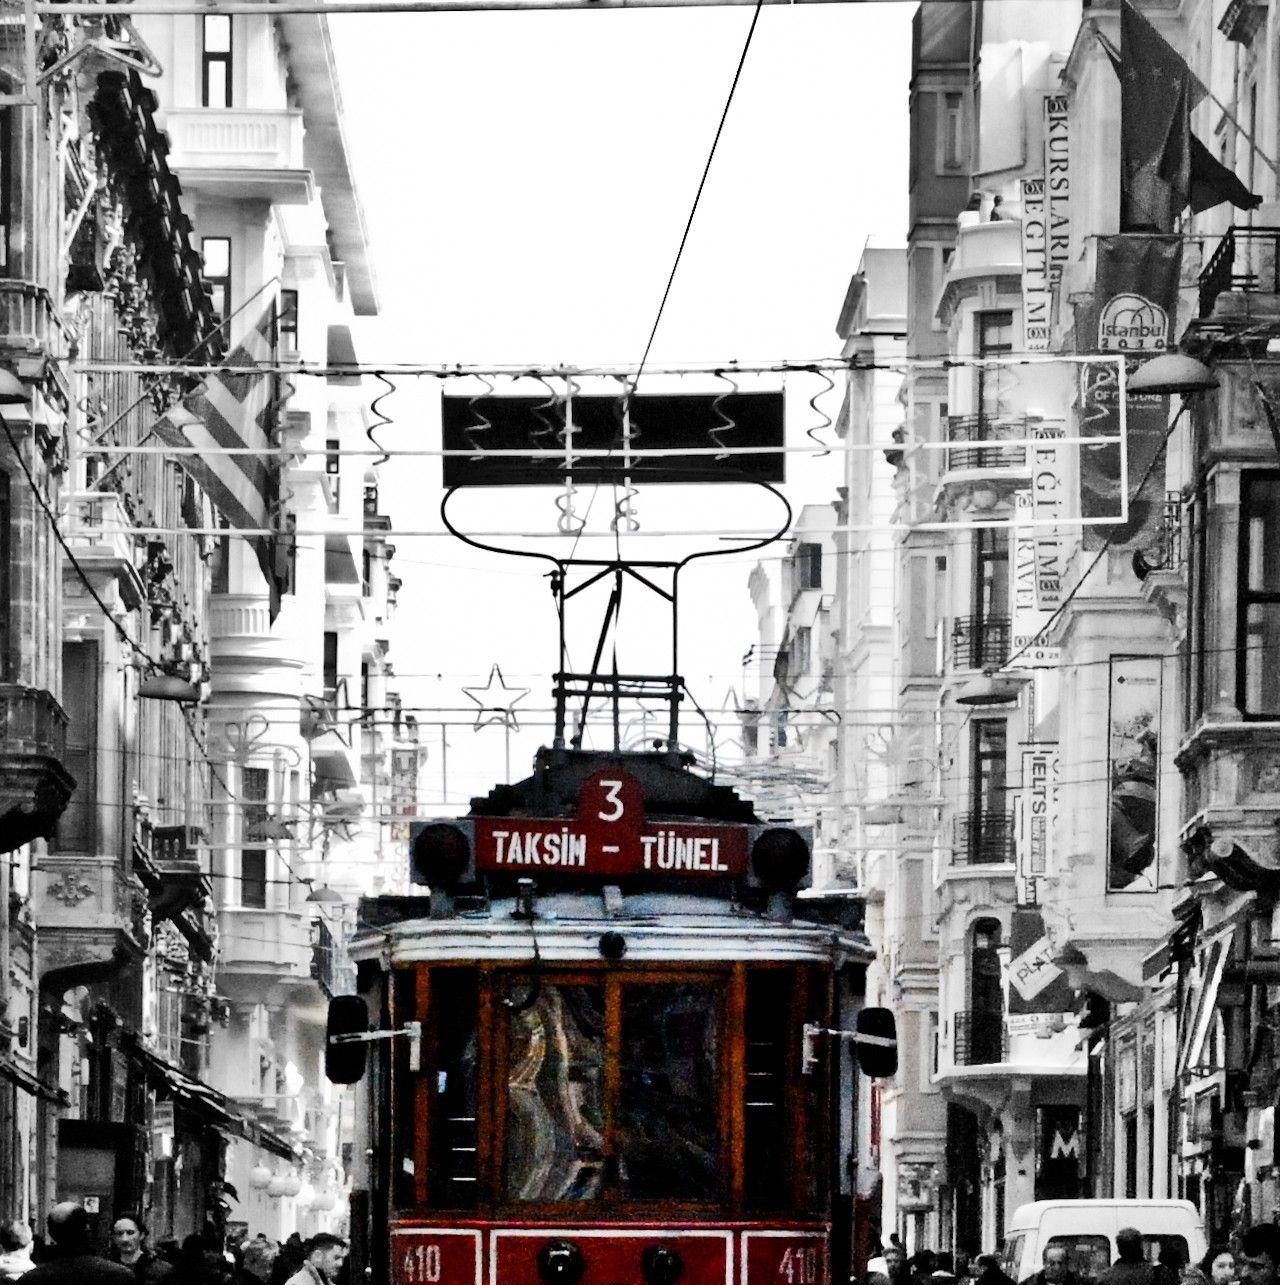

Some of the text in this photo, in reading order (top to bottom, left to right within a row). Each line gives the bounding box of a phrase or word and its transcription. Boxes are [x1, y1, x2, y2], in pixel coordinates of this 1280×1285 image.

[1048, 114, 1071, 264] KURSLARI
[1101, 338, 1165, 349] 2010
[1036, 449, 1063, 577] EĞİİM
[598, 780, 625, 822] 3
[1032, 756, 1047, 815] IELTS
[640, 830, 729, 872] TÜNEL
[404, 1244, 441, 1282] 410
[778, 1247, 817, 1284] 410
